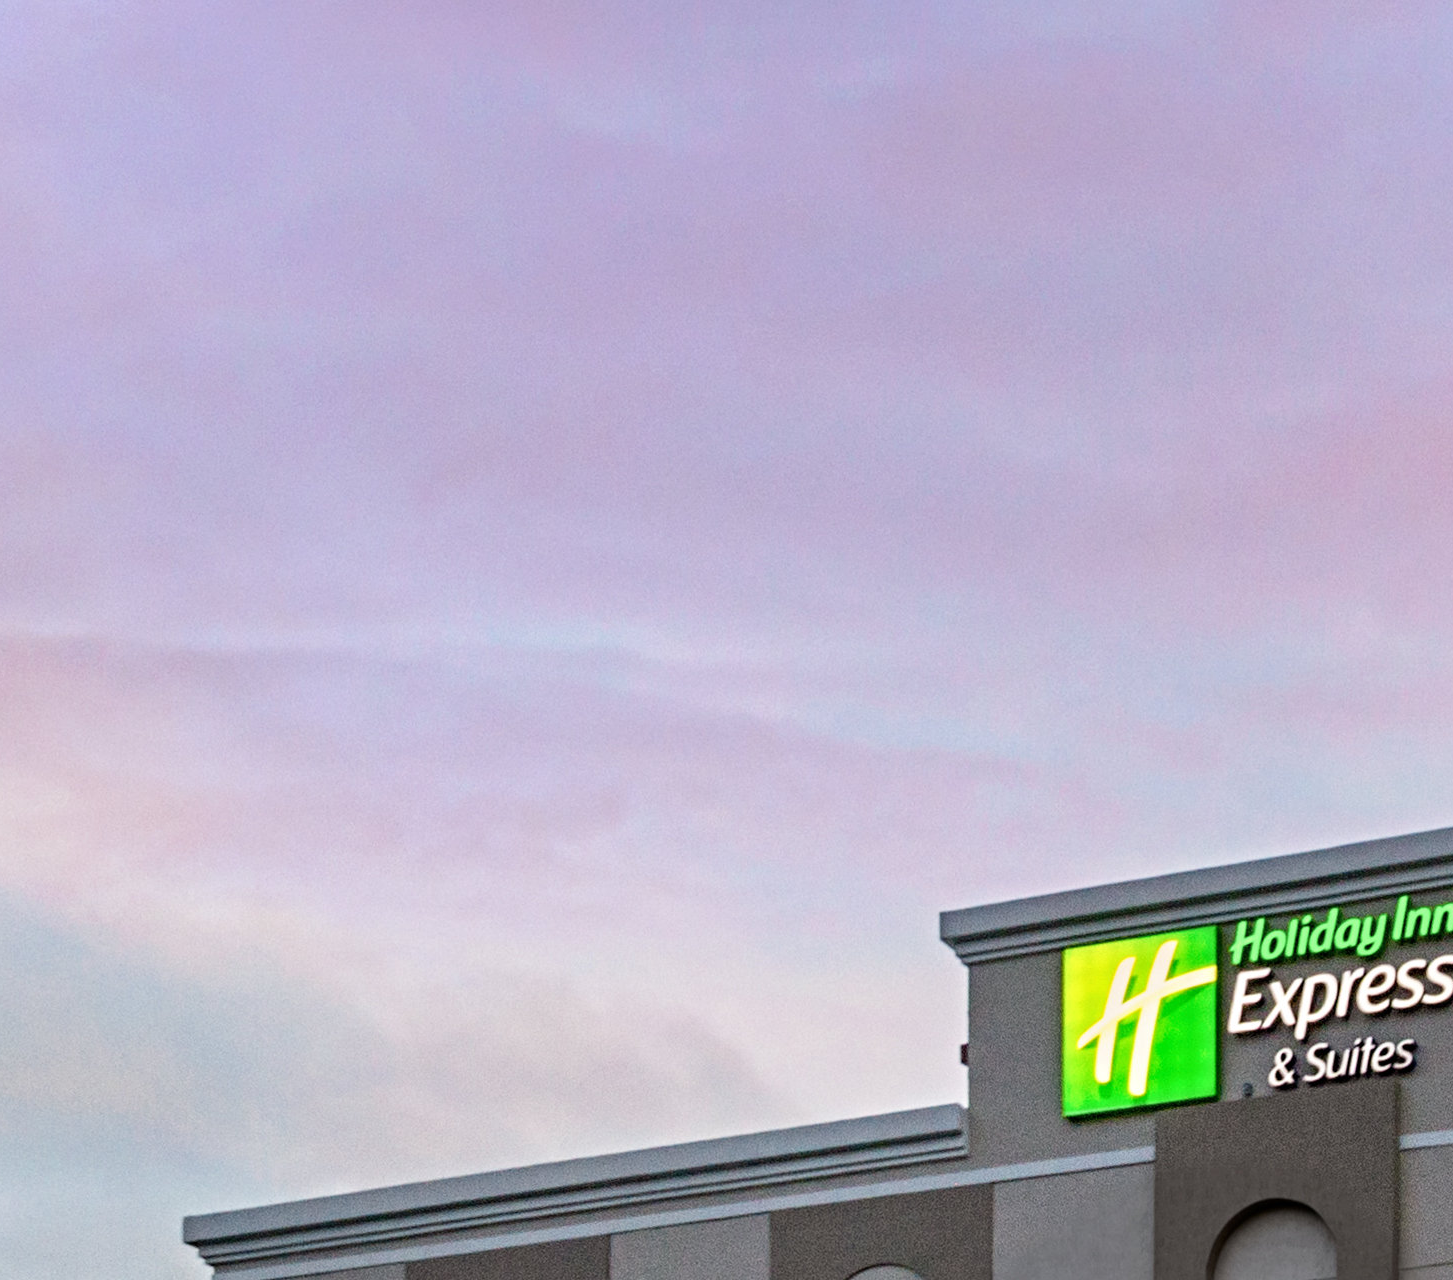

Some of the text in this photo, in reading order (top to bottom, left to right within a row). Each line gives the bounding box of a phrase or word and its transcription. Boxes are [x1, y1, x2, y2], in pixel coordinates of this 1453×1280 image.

[1229, 907, 1388, 965] Holiday
[1268, 1036, 1415, 1087] & Suites
